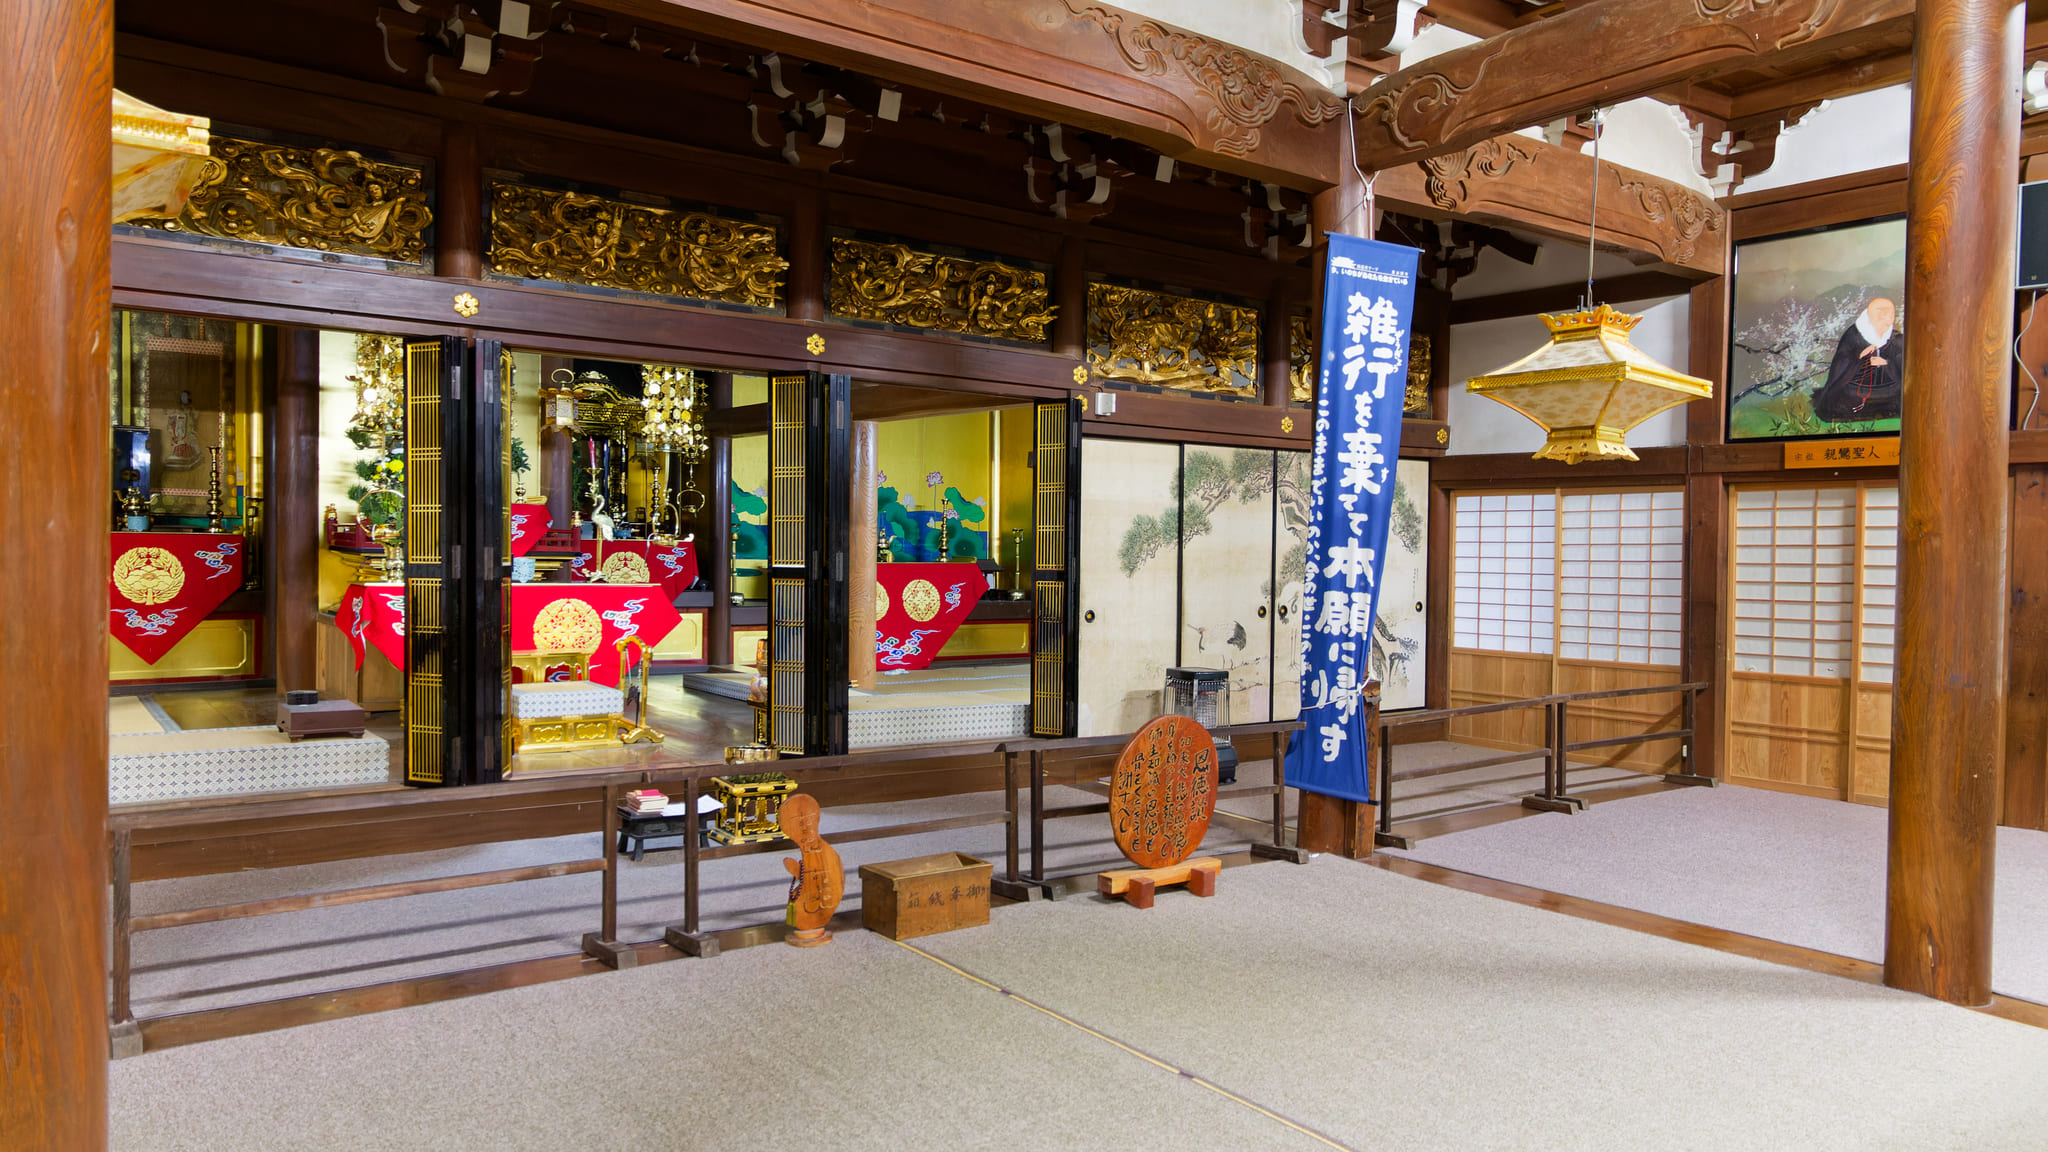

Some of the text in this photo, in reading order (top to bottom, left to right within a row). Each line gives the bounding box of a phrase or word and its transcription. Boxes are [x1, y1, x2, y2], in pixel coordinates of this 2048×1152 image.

[1311, 292, 1398, 762] 雑行を棄てて本願に帰す
[1823, 446, 1880, 461] 親鸞聖人
